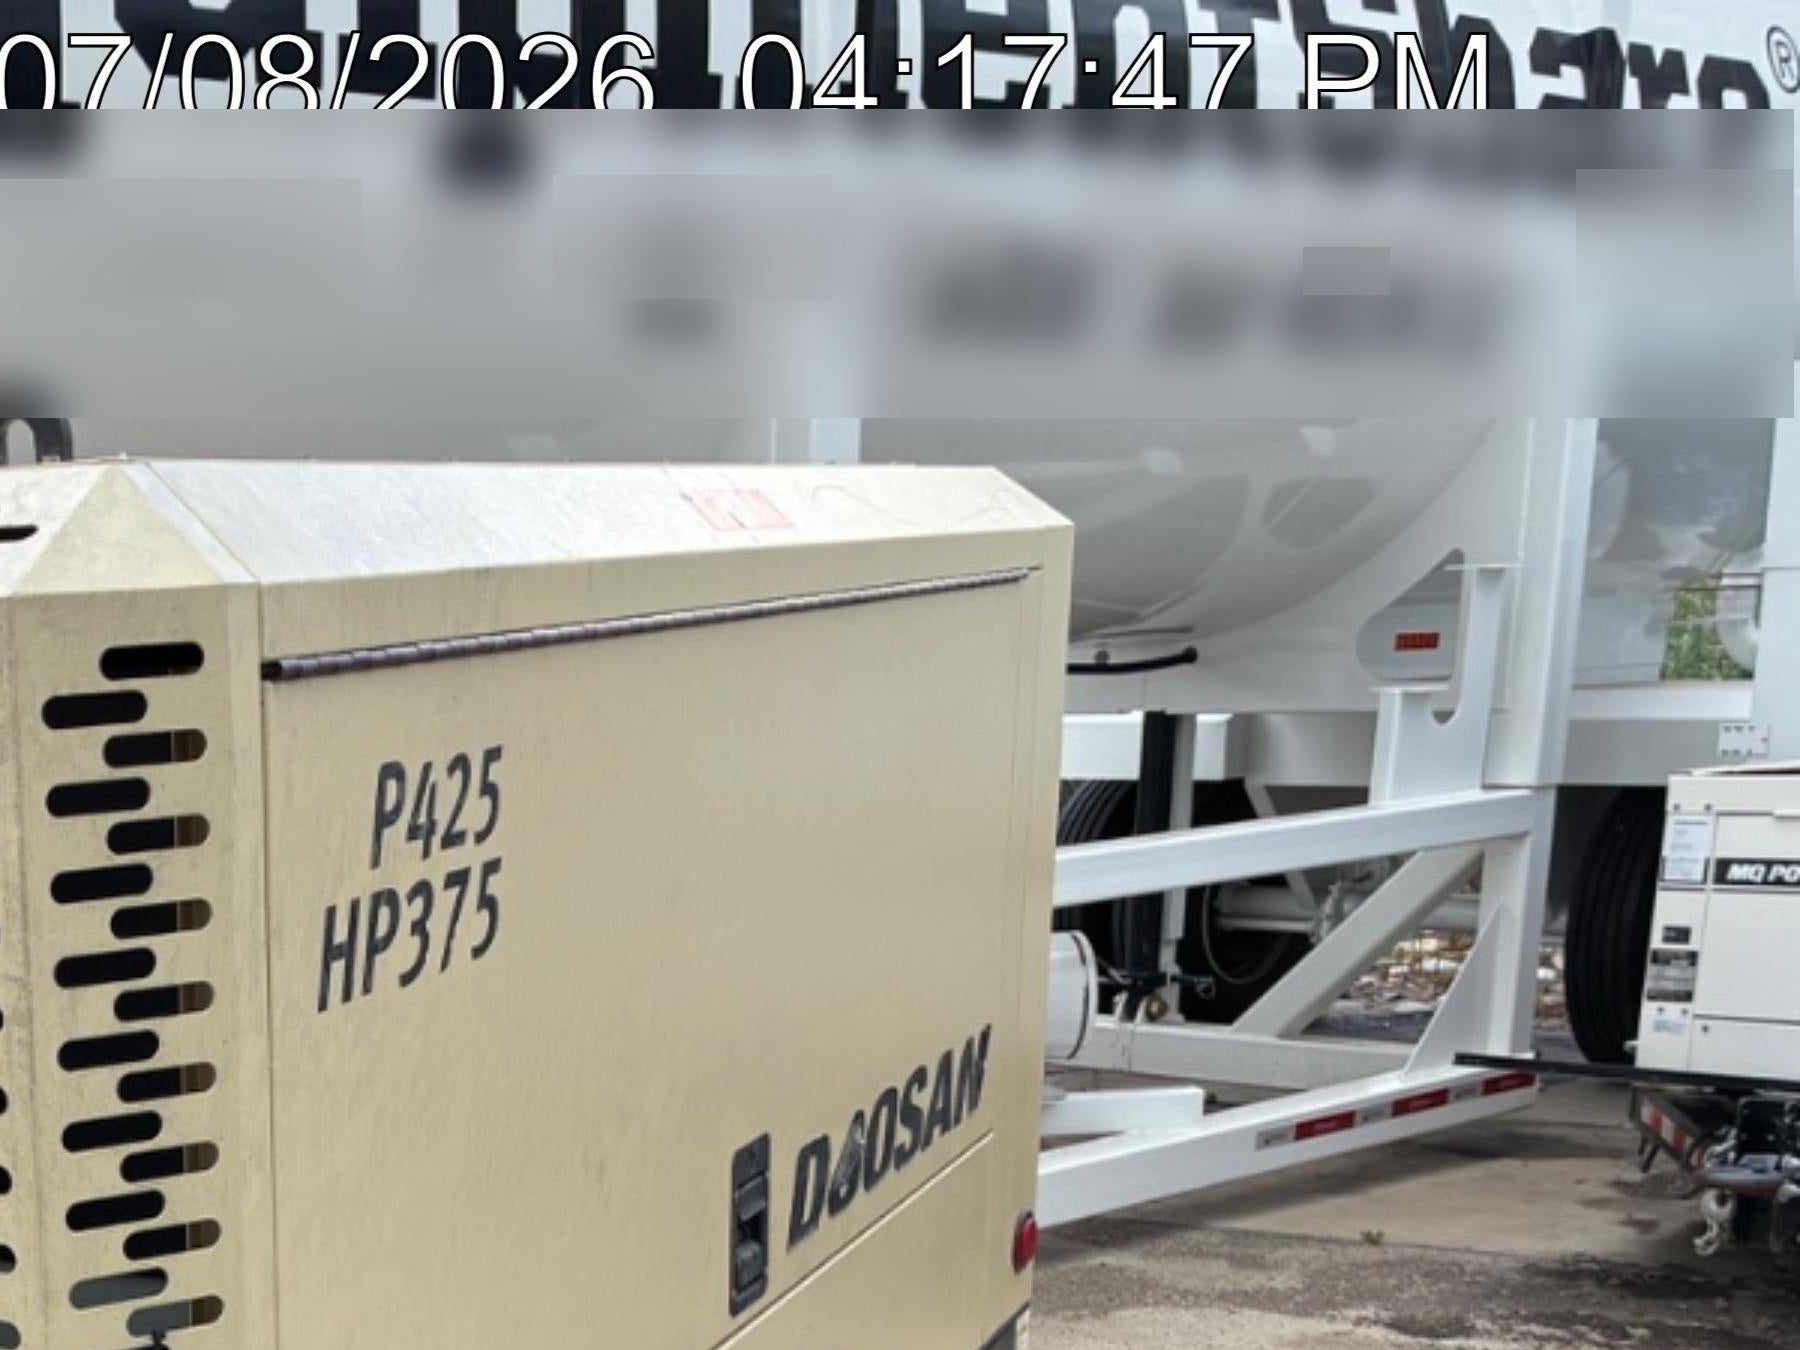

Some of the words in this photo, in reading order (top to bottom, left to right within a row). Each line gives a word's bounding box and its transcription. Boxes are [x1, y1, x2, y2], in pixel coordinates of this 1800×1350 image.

[369, 744, 504, 871] P425
[1726, 862, 1764, 882] MQ
[317, 856, 503, 1015] HP375
[786, 1021, 993, 1254] DOOSAN
